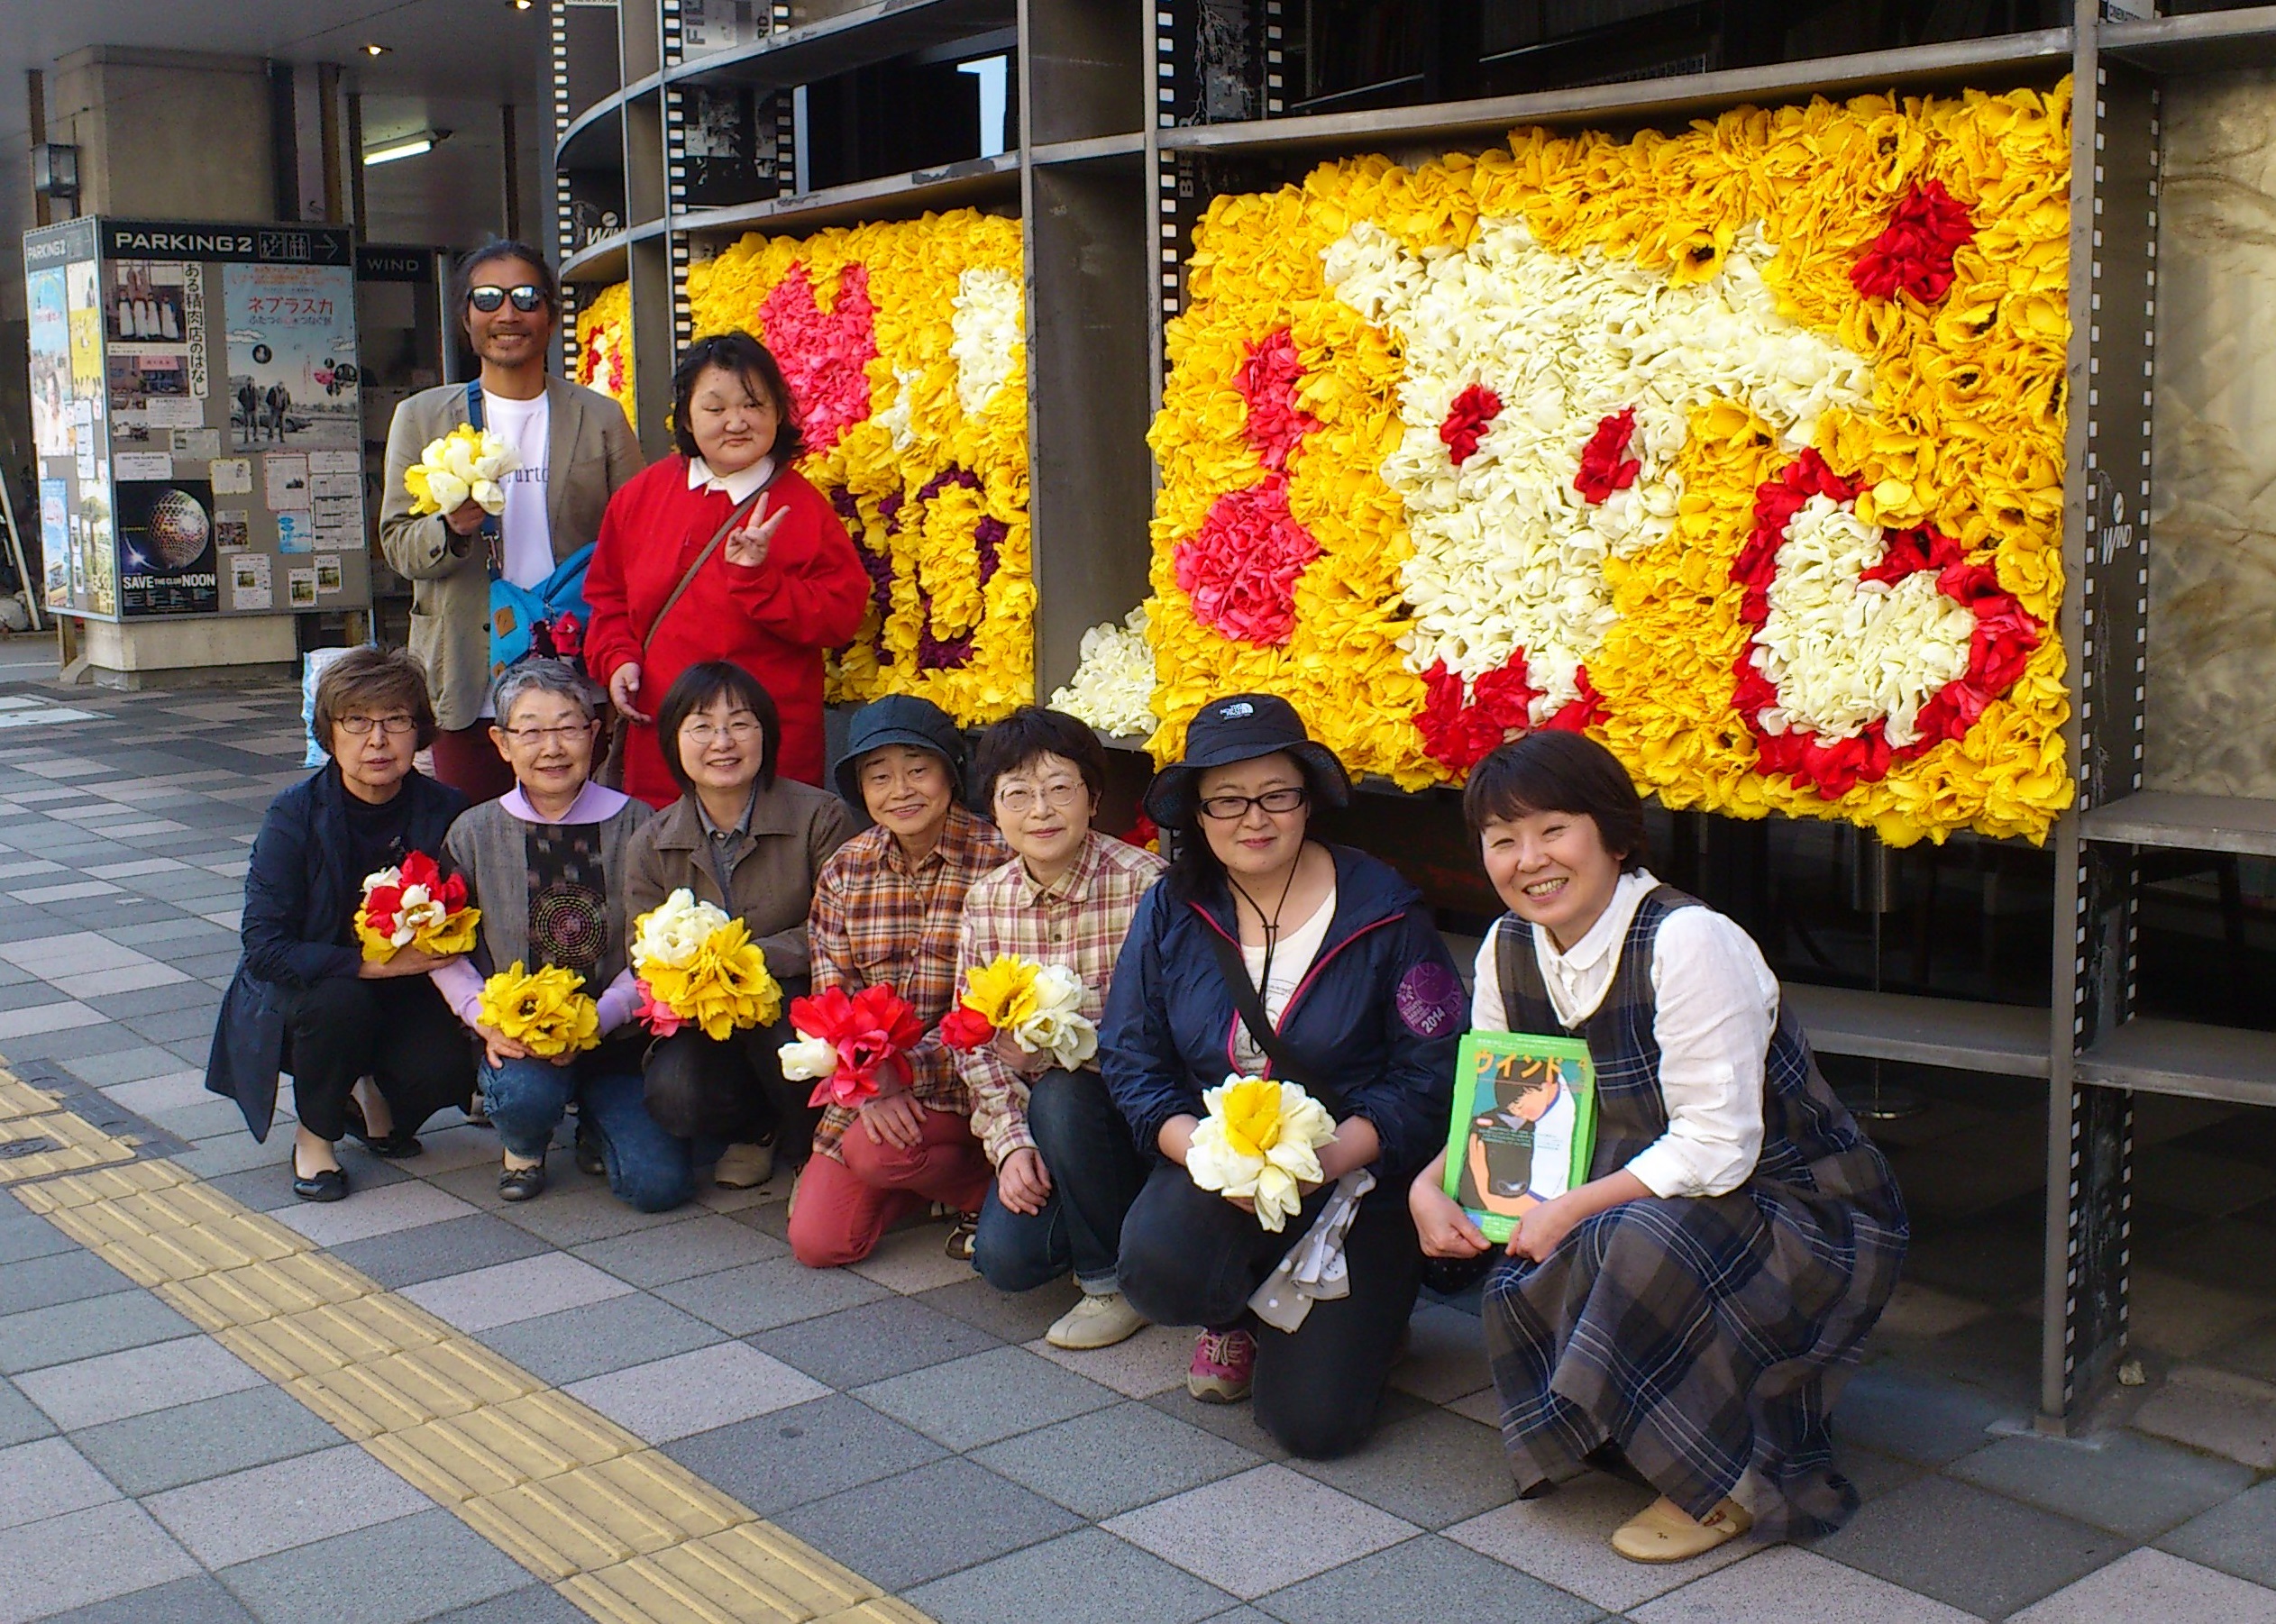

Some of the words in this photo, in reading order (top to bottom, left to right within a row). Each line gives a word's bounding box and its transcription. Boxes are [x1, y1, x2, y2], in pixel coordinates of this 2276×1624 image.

[366, 258, 419, 271] WIND
[248, 297, 334, 315] ネブラスカ
[2102, 524, 2133, 565] WIND
[123, 575, 155, 589] SAVE
[181, 573, 215, 588] NOON
[1421, 1006, 1447, 1034] 2014
